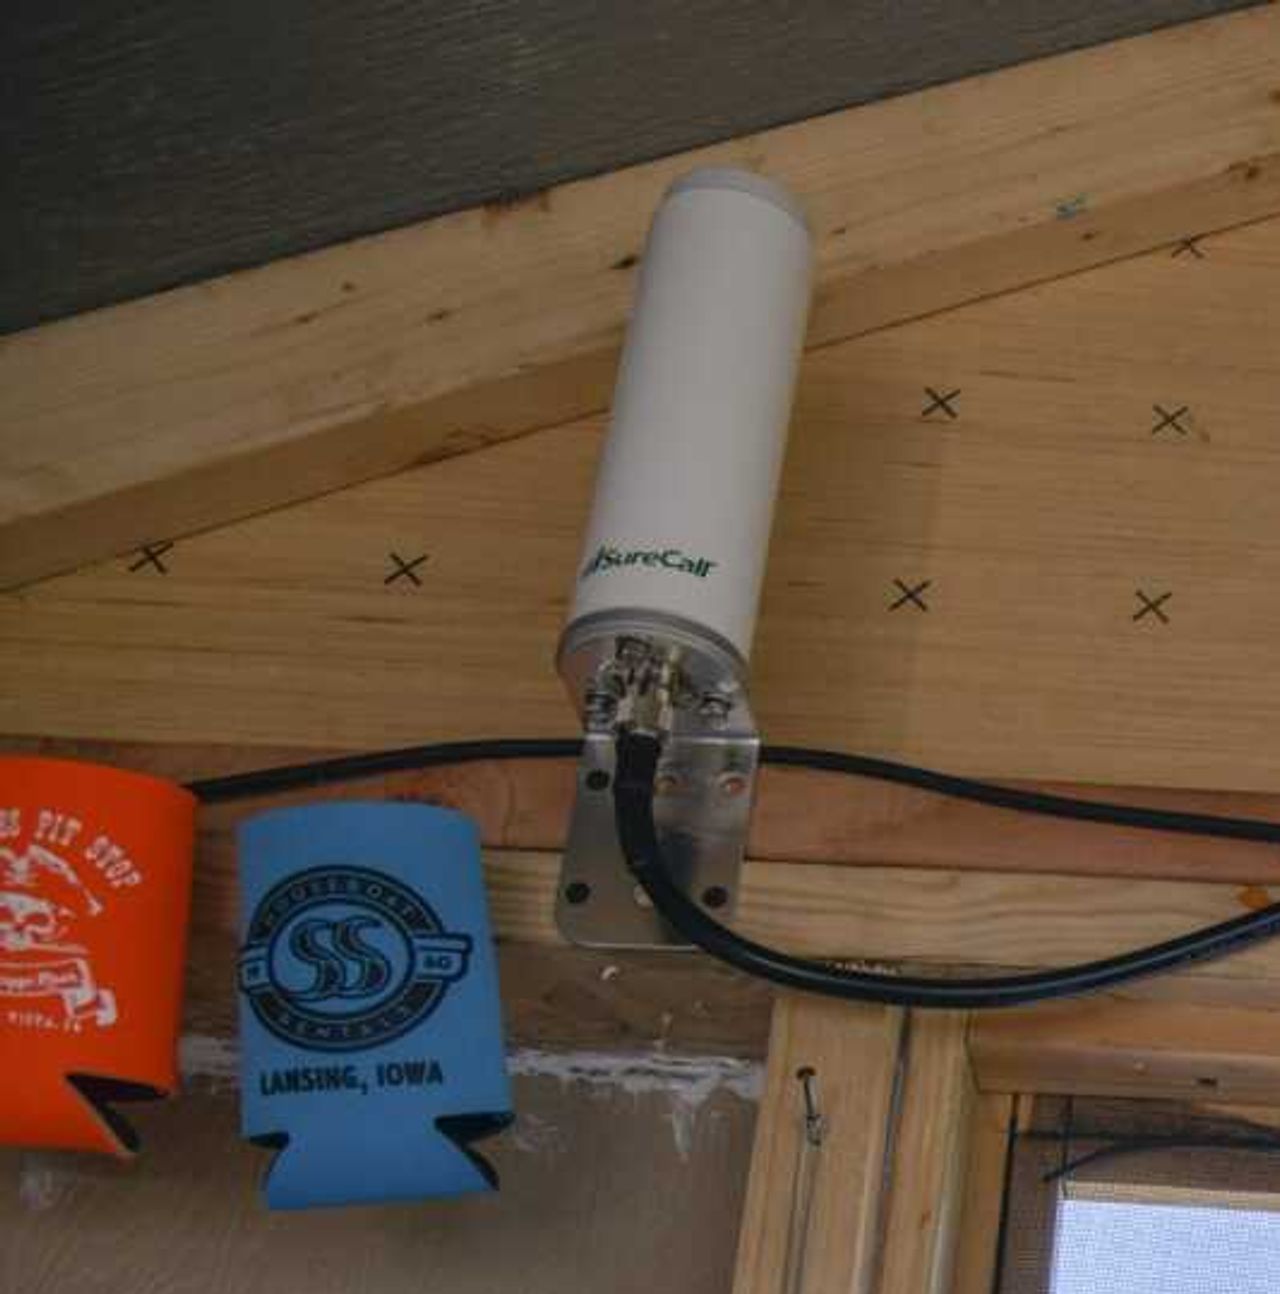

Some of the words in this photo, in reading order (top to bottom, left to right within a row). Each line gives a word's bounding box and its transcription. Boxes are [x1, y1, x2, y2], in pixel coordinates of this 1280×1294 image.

[598, 547, 714, 577] SureCall
[84, 835, 143, 890] STOP
[259, 1064, 368, 1097] LANSING,
[376, 1060, 443, 1090] IOWA
